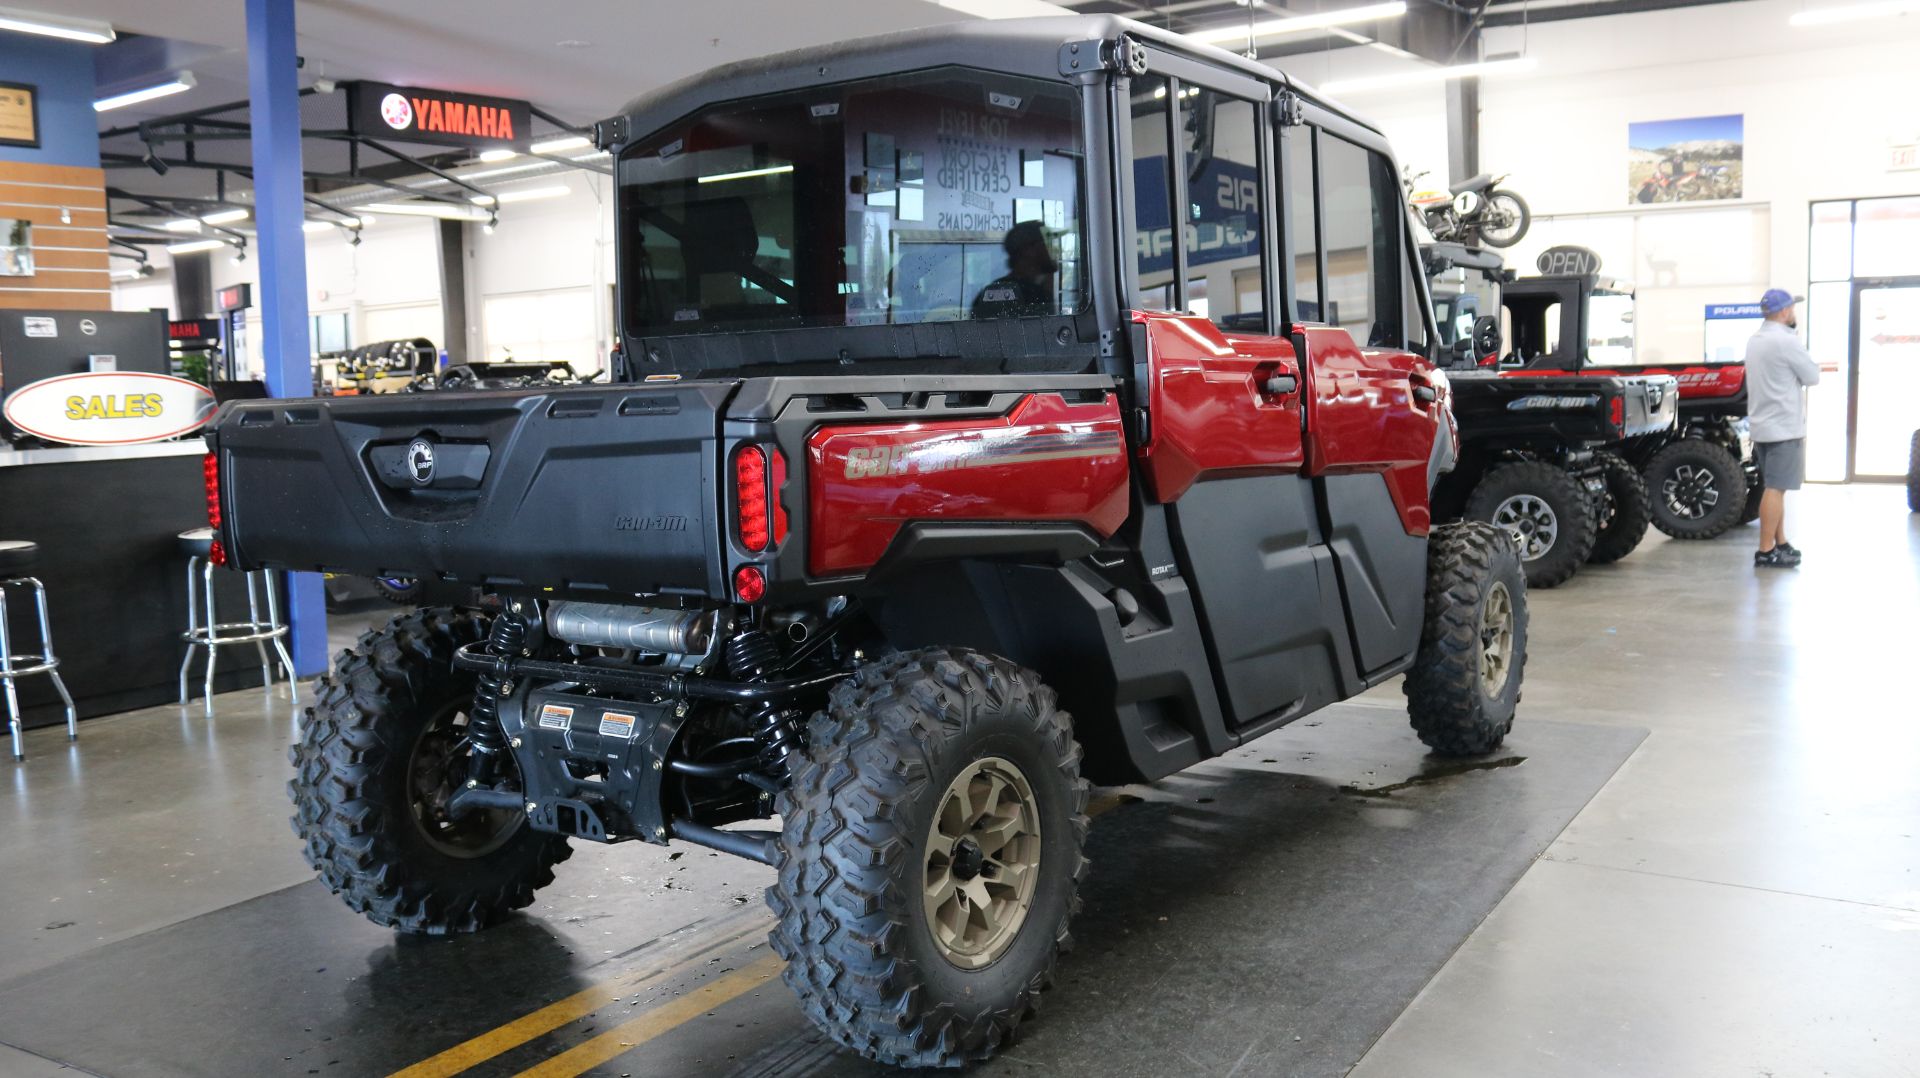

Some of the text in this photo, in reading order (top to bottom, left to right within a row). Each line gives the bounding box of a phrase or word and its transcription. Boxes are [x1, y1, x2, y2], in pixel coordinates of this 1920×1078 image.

[412, 98, 514, 140] YAMAHA
[1892, 149, 1916, 167] EXIT
[1462, 195, 1469, 210] 1
[1539, 252, 1590, 276] OPEN
[65, 393, 163, 420] SALES
[1526, 396, 1586, 408] can-am
[417, 461, 432, 469] BRP
[616, 515, 687, 531] can-am
